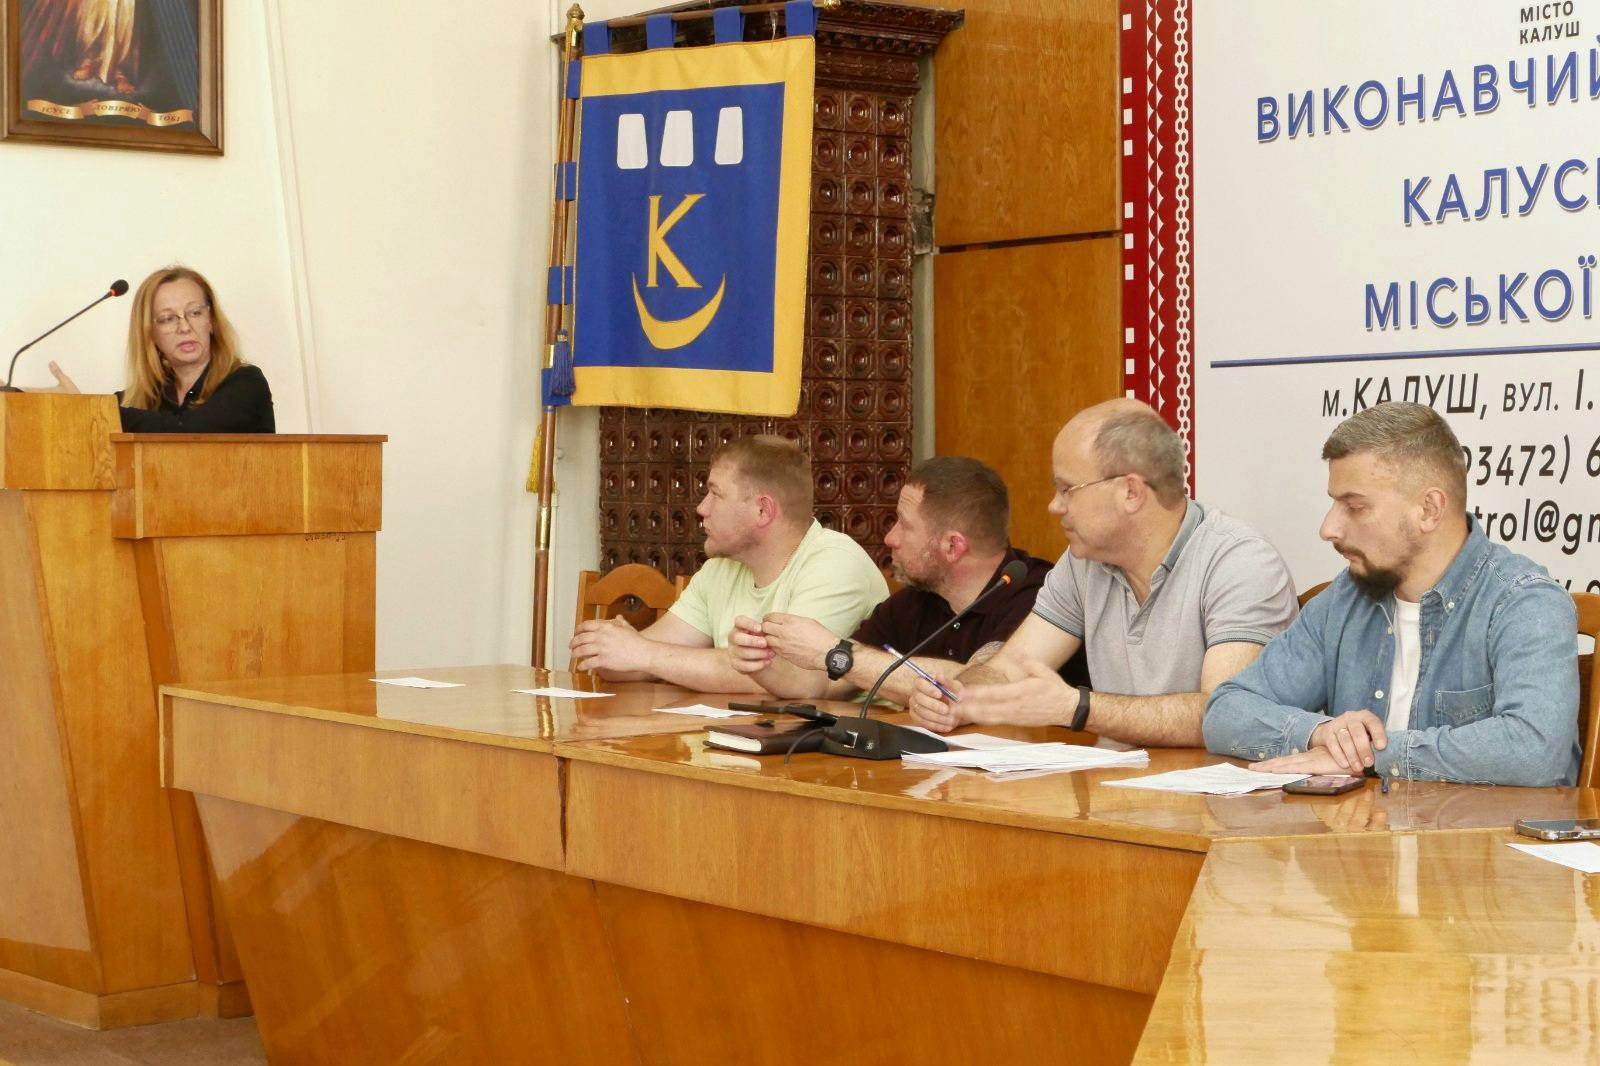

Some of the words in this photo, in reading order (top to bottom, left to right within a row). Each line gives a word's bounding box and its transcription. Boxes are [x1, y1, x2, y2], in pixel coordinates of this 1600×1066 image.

[1520, 0, 1574, 23] МІСТО
[1519, 21, 1580, 45] КАЛУШ
[1403, 157, 1600, 227] КАЛУС
[1365, 254, 1597, 331] МІСЬКОЇ
[1503, 381, 1559, 412] вул.
